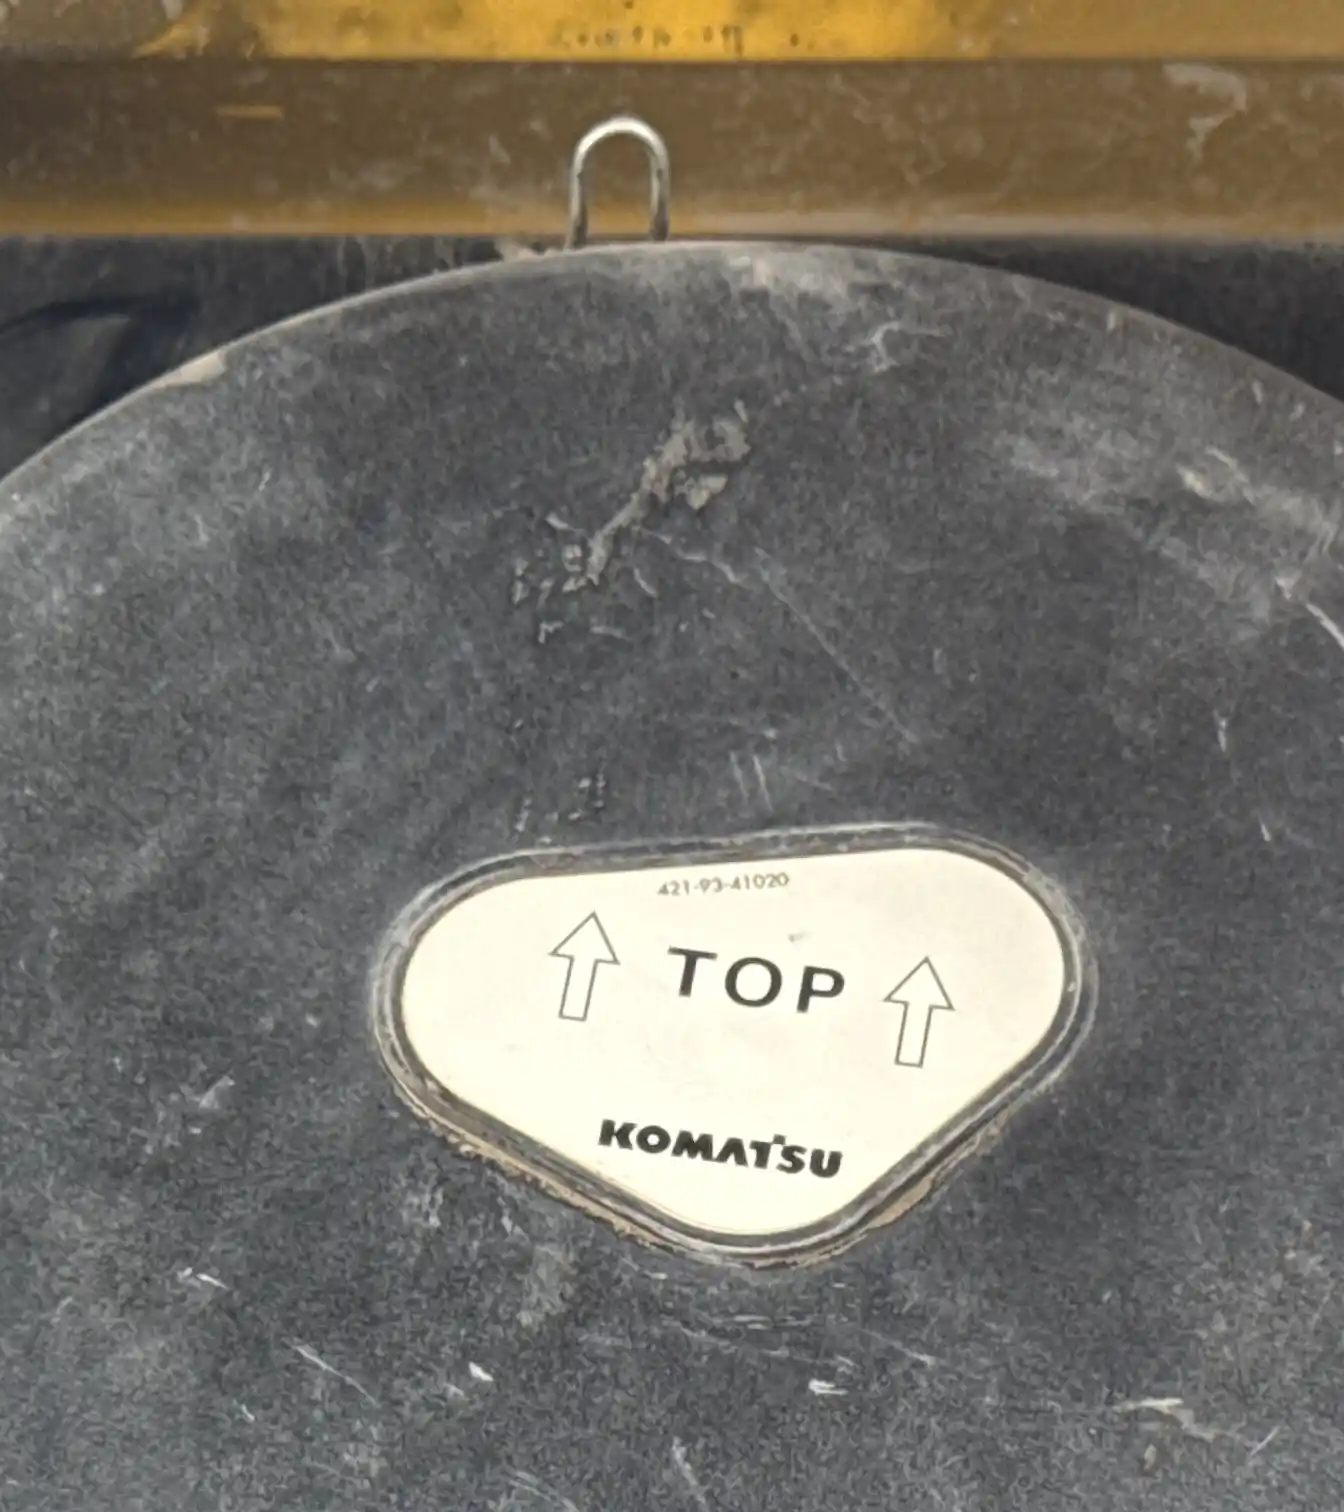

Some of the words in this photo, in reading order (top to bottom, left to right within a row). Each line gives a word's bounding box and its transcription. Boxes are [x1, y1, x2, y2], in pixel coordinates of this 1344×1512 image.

[657, 871, 790, 897] 421-93-41020
[666, 946, 846, 1014] TOP
[597, 1117, 844, 1180] KOMATSU
